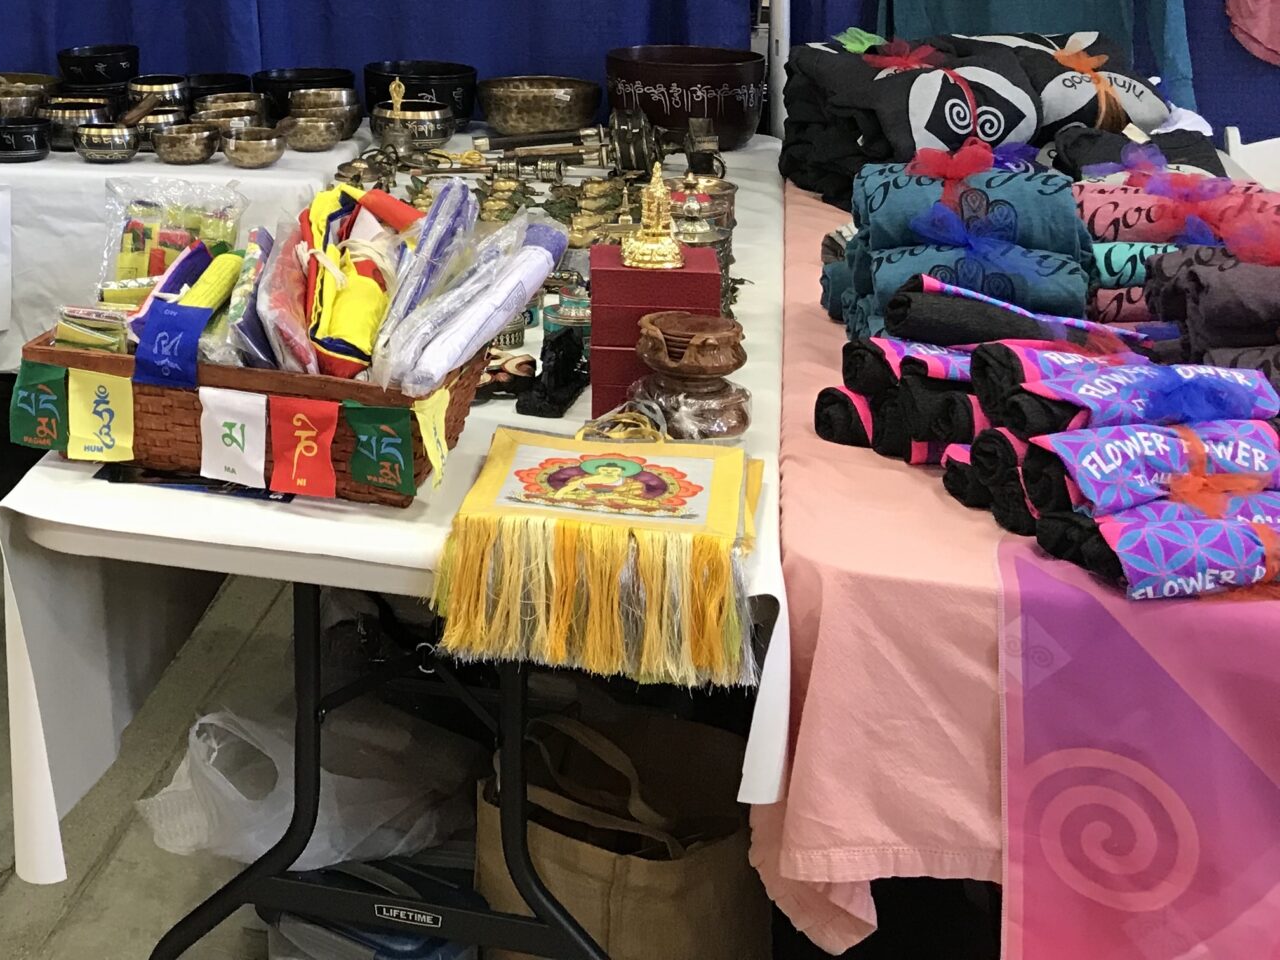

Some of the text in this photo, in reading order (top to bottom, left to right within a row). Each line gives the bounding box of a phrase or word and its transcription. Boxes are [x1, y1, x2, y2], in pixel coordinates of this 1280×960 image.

[1087, 201, 1169, 241] Goo
[1078, 365, 1253, 400] FLOWER OWER
[23, 436, 51, 446] PADME
[84, 445, 104, 453] HUM
[1081, 430, 1171, 480] FLOWER
[224, 465, 237, 475] MA
[296, 478, 307, 487] NI
[1132, 568, 1237, 601] FLOWER
[383, 907, 434, 924] LIFETIME
